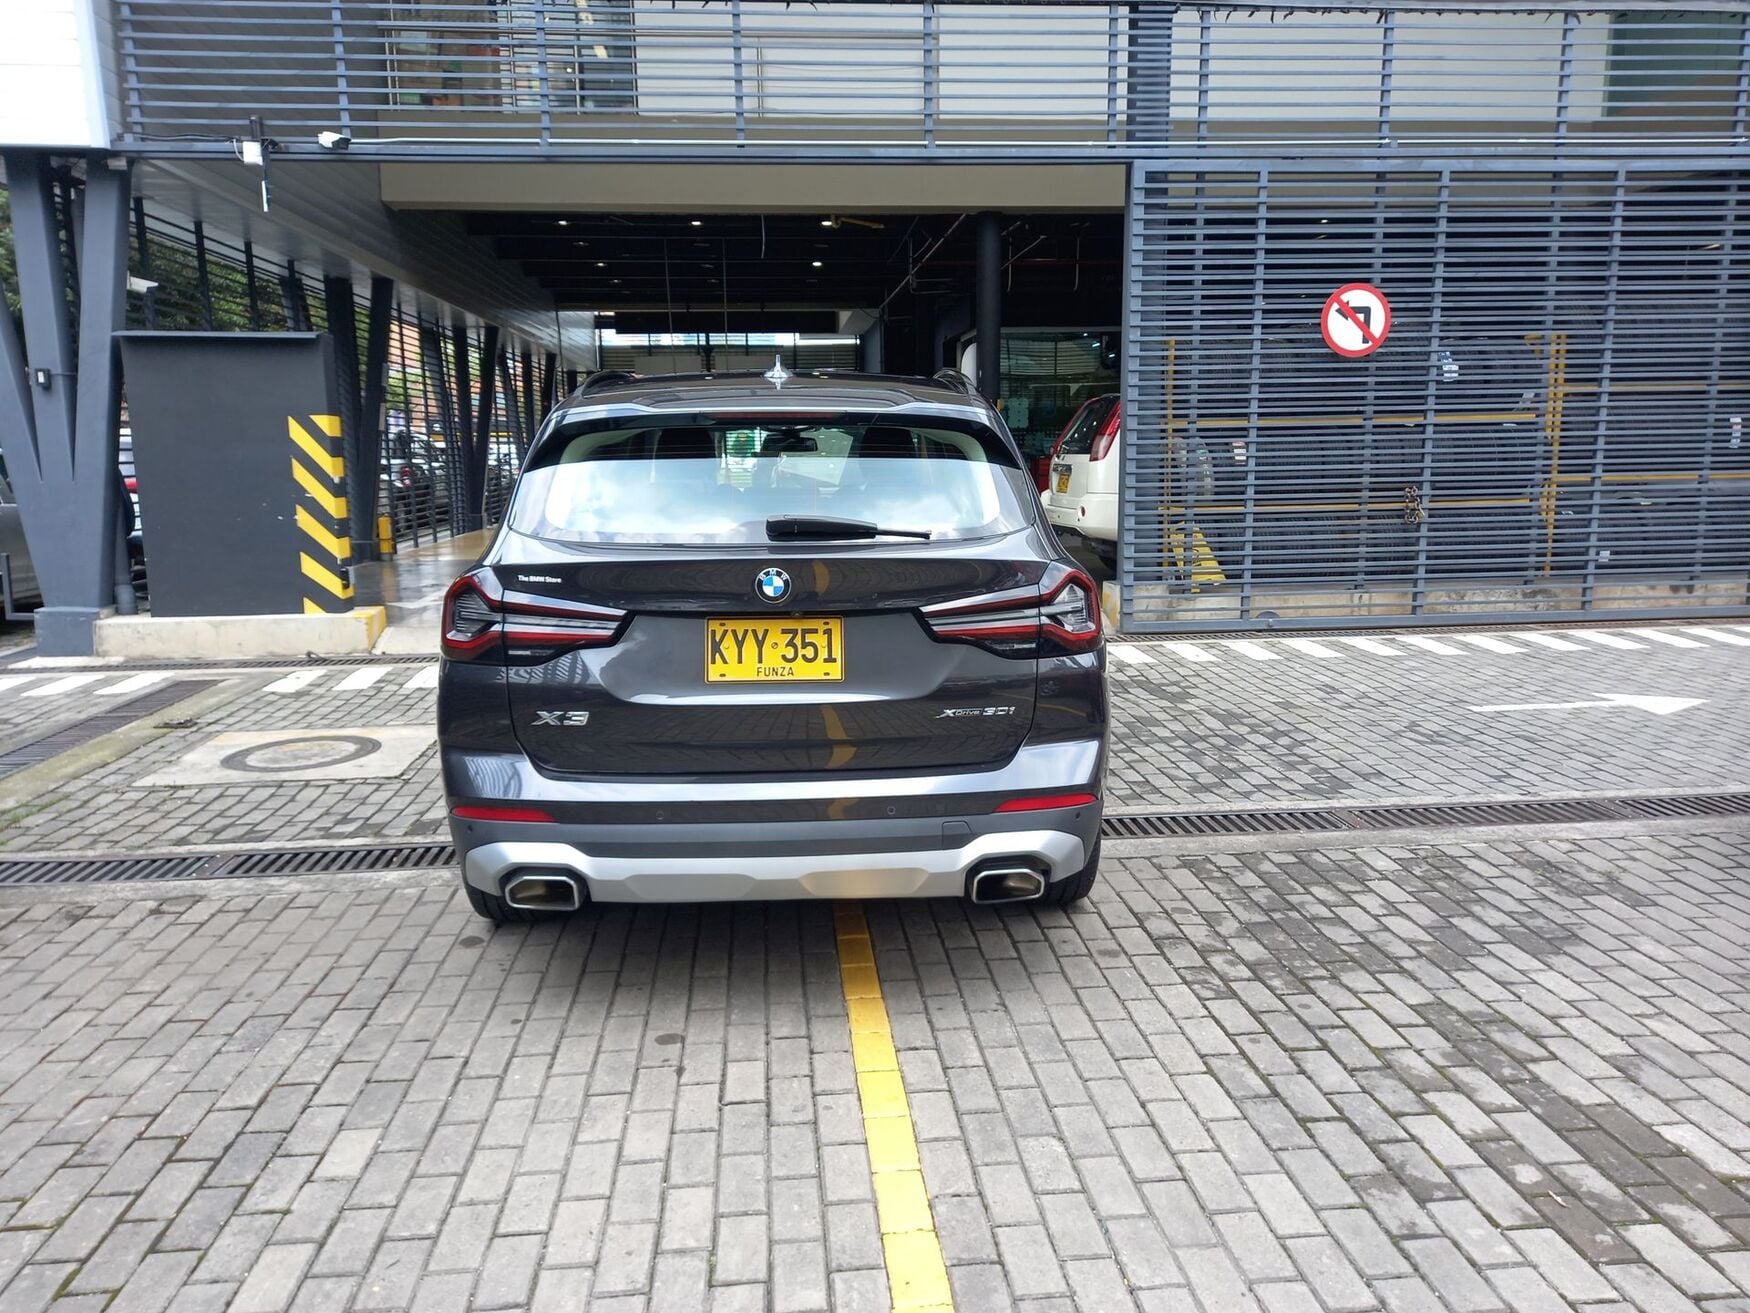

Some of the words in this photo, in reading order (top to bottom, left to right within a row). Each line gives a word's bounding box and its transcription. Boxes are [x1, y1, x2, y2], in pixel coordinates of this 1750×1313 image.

[710, 628, 770, 665] KYY
[780, 627, 837, 663] 351
[756, 666, 795, 677] FUNZA
[530, 710, 590, 726] X3
